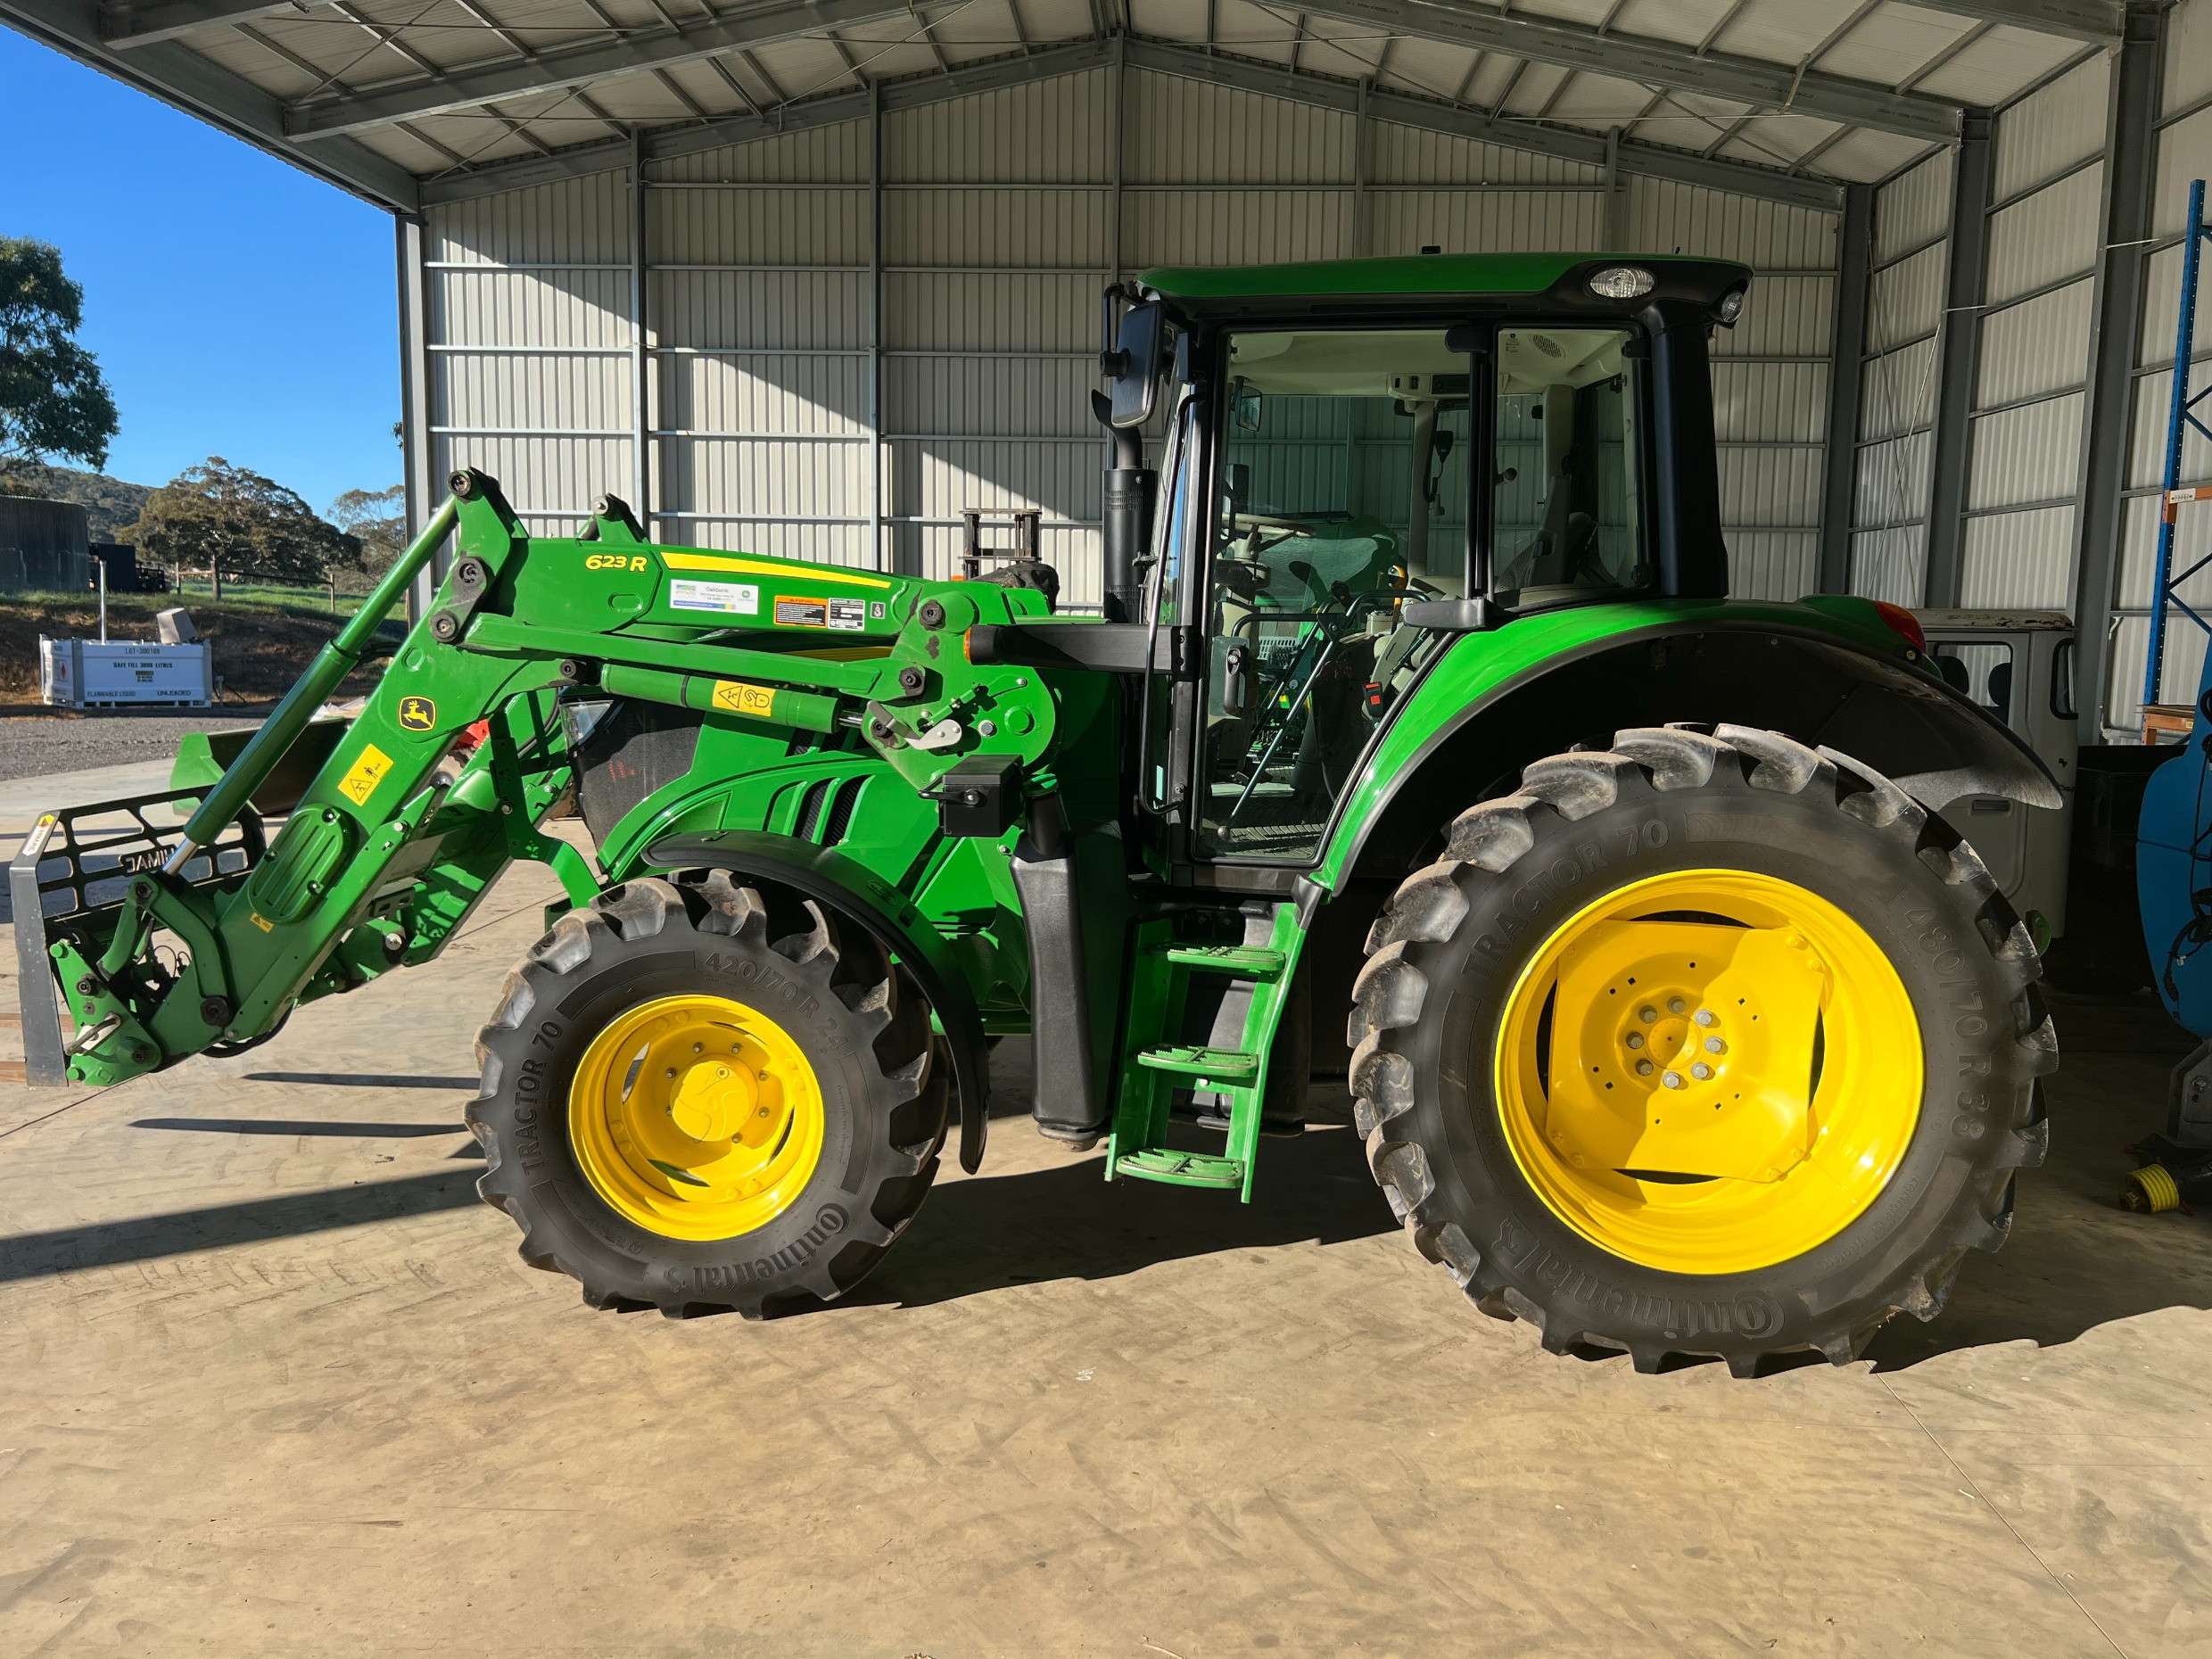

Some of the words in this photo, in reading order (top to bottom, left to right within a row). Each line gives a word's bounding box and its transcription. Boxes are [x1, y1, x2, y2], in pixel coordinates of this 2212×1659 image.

[585, 554, 628, 570] 623
[629, 556, 648, 573] R
[1460, 840, 1609, 981] TRACTOR
[1614, 819, 1671, 857] 70
[703, 951, 799, 1000] 420/70
[798, 995, 821, 1020] R
[1903, 906, 1988, 1040] 480/70
[530, 1020, 564, 1052] 70
[1956, 1053, 1993, 1078] R
[514, 1057, 547, 1176] TRACTOR
[1951, 1092, 1991, 1141] 38
[692, 1201, 850, 1296] Continental
[1513, 1239, 1786, 1341] Continental
